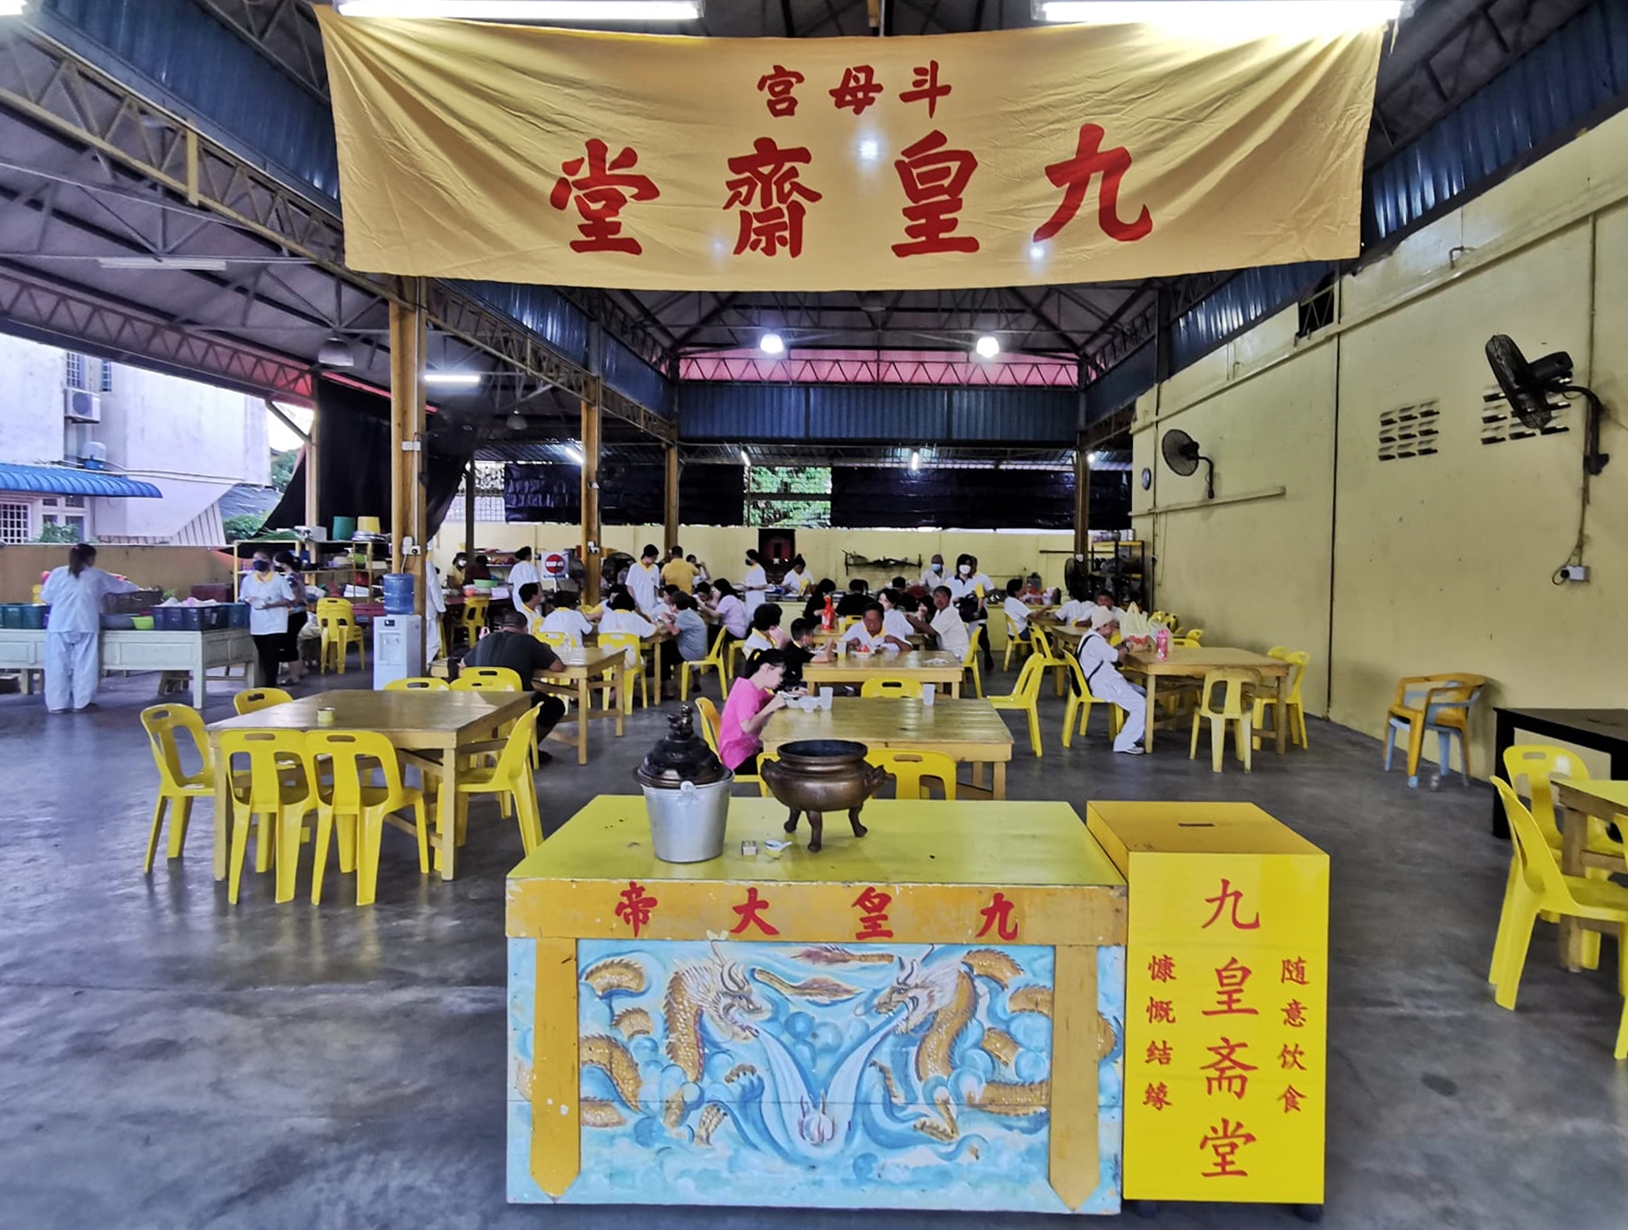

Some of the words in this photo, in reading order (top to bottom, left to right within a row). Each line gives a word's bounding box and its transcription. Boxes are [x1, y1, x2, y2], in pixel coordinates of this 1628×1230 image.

[1200, 878, 1261, 1178] 九皇斋堂
[1277, 955, 1310, 1114] 随意饮食
